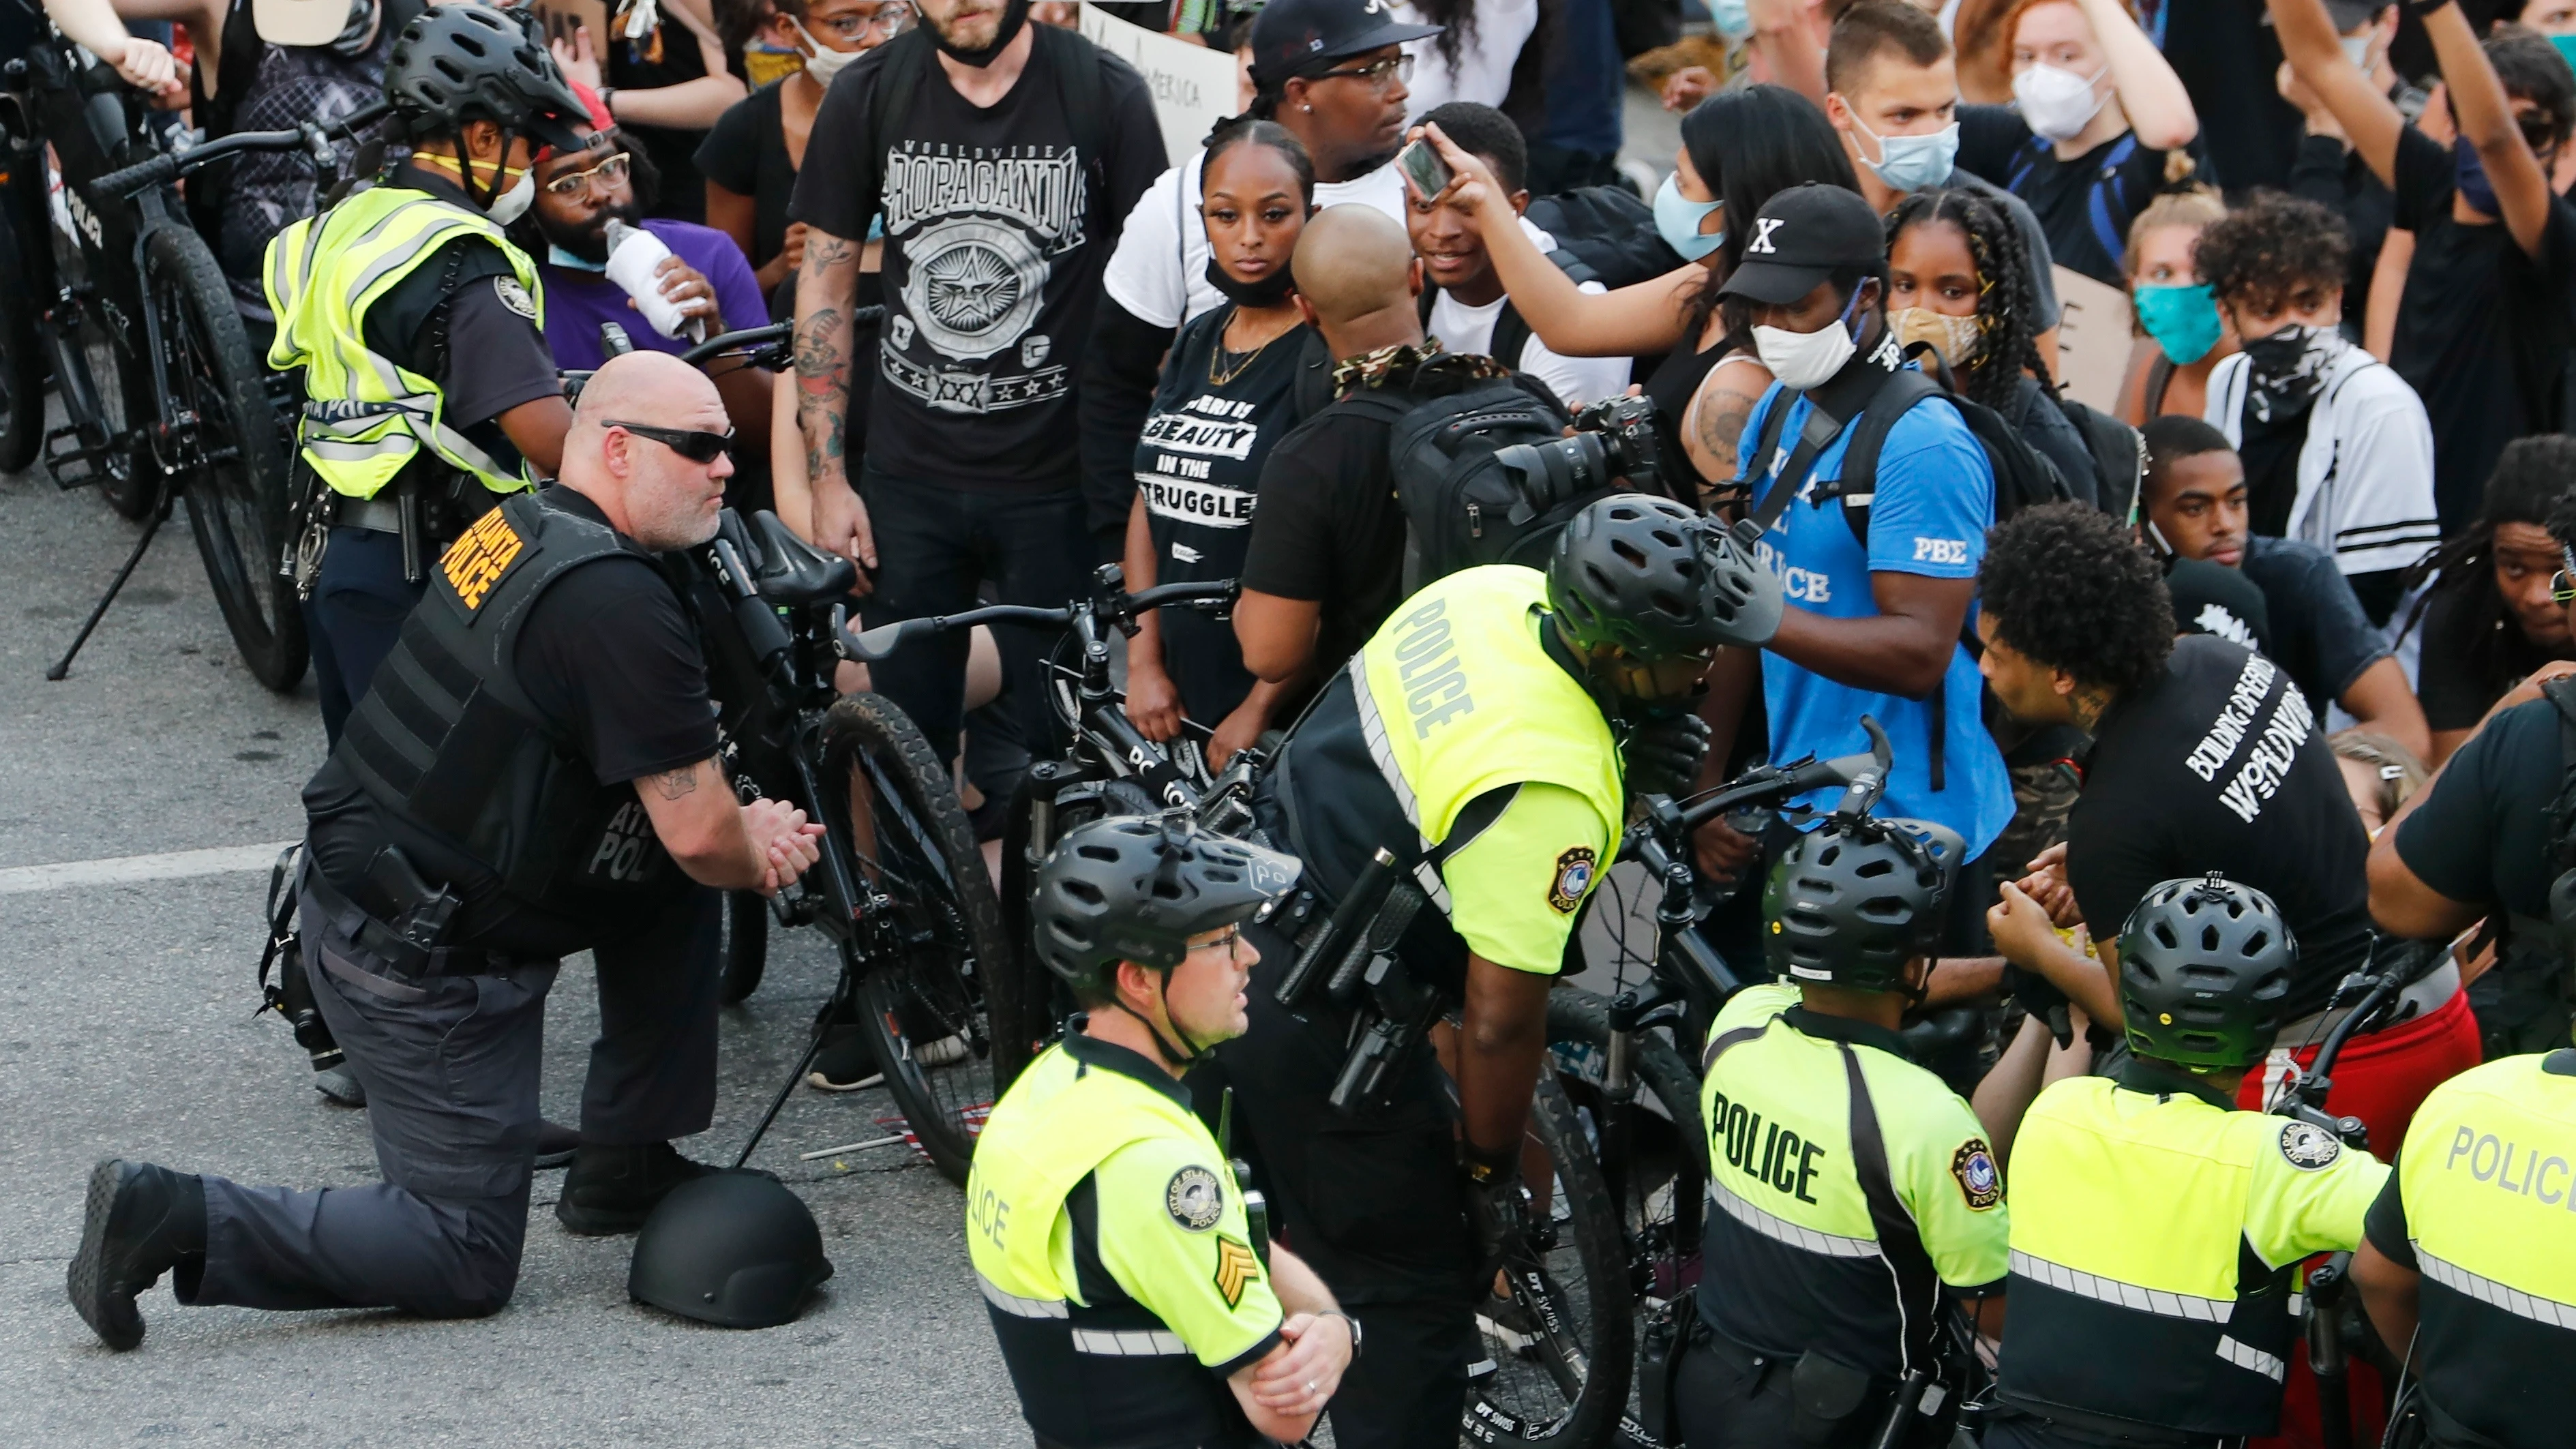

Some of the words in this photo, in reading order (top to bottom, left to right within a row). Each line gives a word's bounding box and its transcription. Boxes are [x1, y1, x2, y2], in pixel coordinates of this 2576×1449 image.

[903, 139, 1055, 160] WORLDWIDE
[1748, 218, 1785, 254] X
[1146, 420, 1249, 449] BEAUTY
[1156, 454, 1178, 473] IN
[1180, 458, 1212, 479] THE
[440, 528, 501, 610] POLICE
[1393, 597, 1474, 741] POLICE
[1713, 1090, 1826, 1206] POLICE
[1170, 1178, 1183, 1193] OF
[1181, 1169, 1218, 1189] ATLANTA
[967, 1161, 1010, 1253] OLICE
[1169, 1195, 1182, 1216] CITY
[1527, 1272, 1543, 1293] DT
[1474, 1401, 1494, 1418] DT
[1489, 1411, 1516, 1433] SWISS
